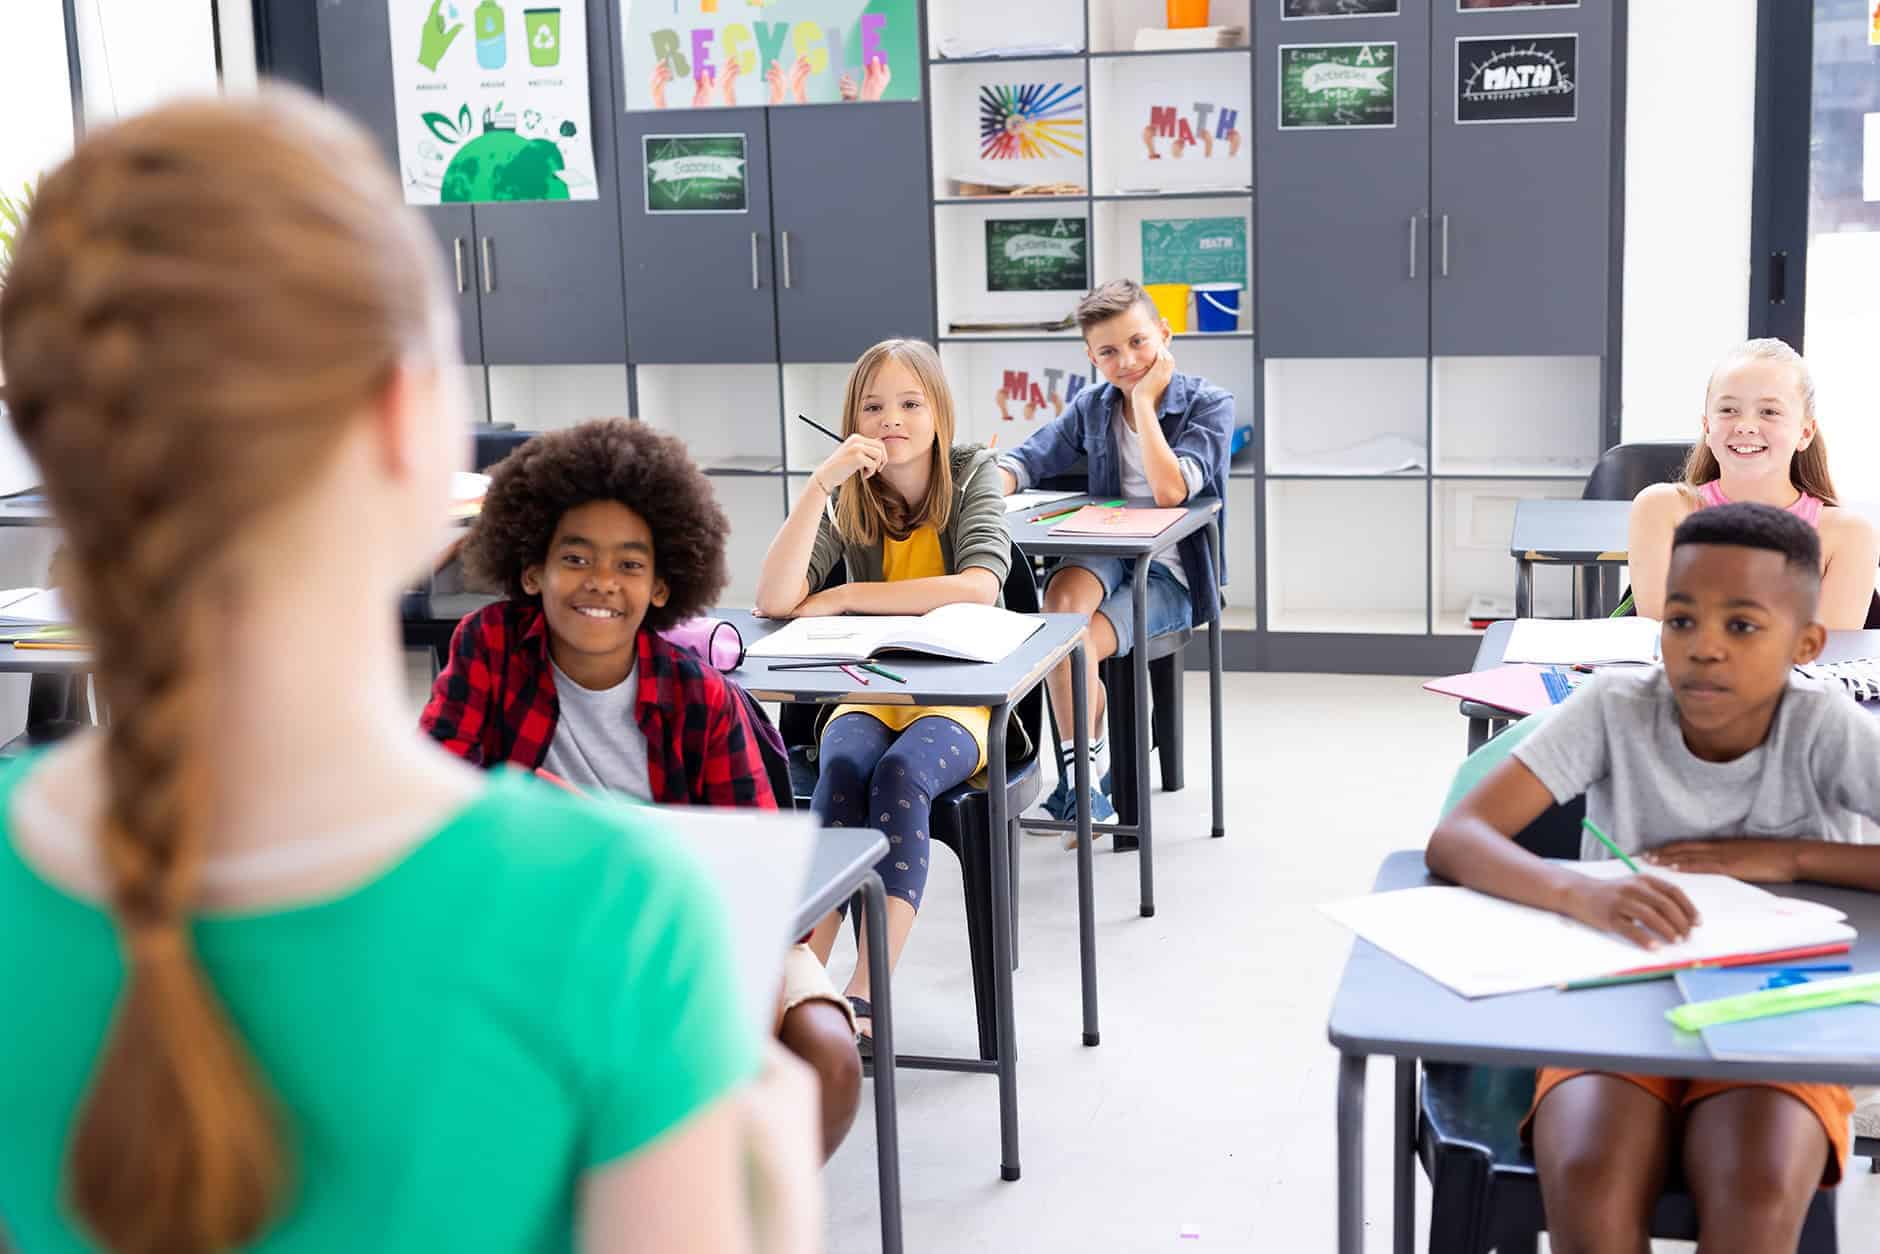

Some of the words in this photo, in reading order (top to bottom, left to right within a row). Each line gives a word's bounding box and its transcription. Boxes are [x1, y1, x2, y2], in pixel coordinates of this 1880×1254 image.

[650, 13, 888, 82] RECYCLE
[1356, 46, 1388, 65] A+
[1483, 64, 1552, 91] MATH
[1151, 102, 1238, 145] MATH
[1051, 218, 1080, 236] A+
